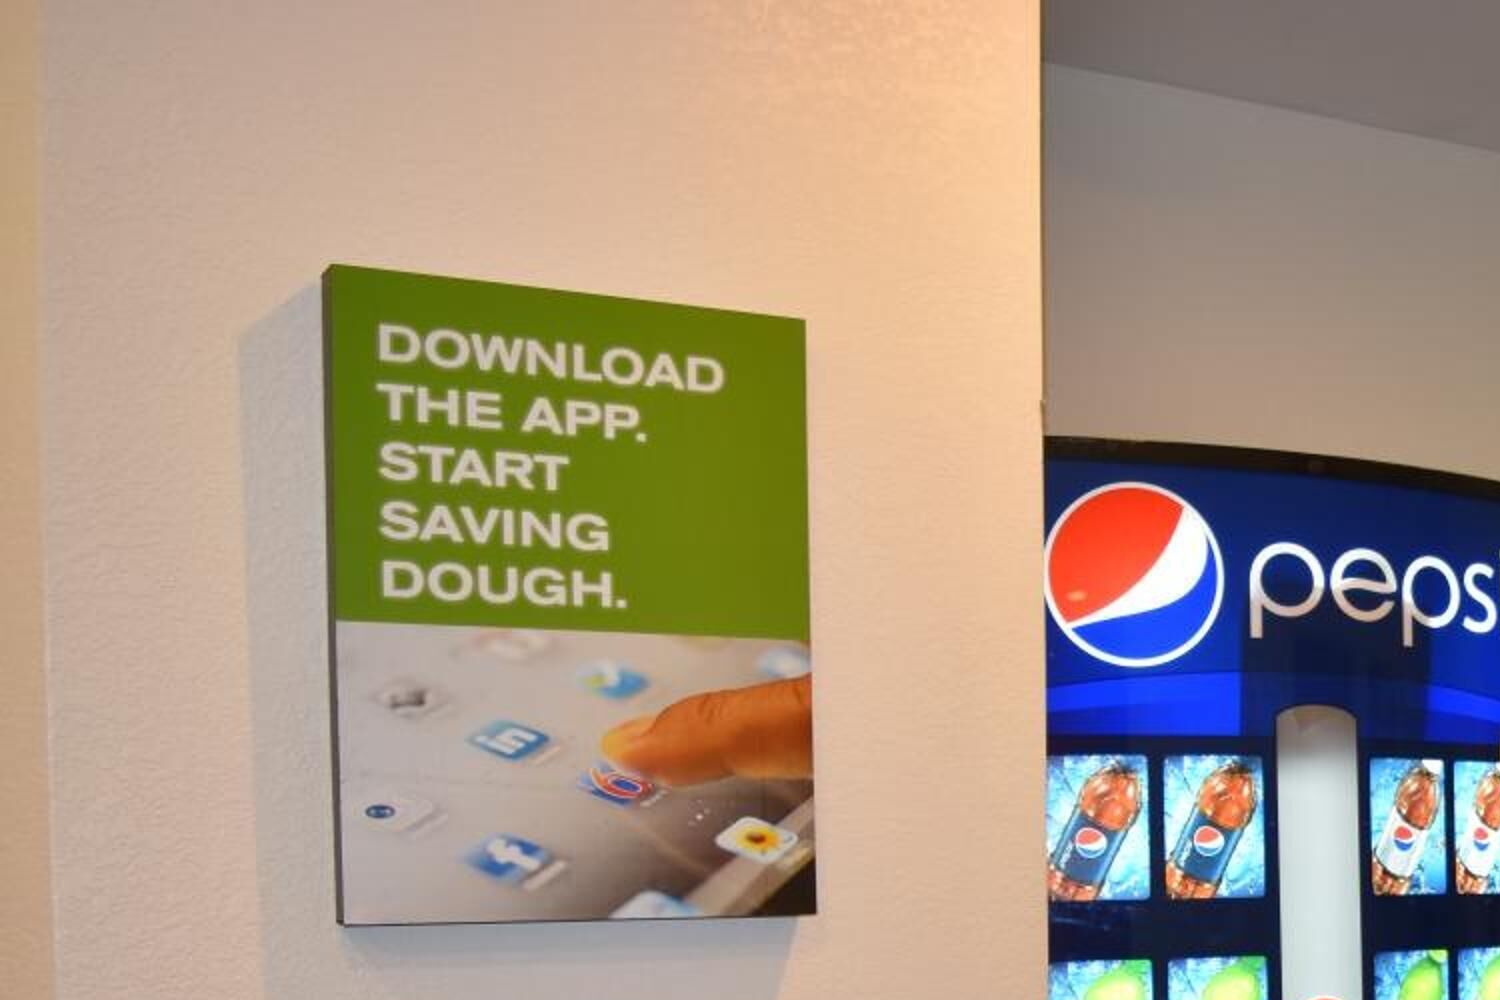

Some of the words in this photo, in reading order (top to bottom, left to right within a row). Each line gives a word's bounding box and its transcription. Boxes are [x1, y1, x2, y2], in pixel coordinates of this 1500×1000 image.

[377, 323, 725, 394] DOWNLOAD
[376, 383, 504, 430] THE
[521, 397, 648, 443] APP.
[379, 442, 569, 492] START
[379, 501, 610, 552] SAVING
[382, 560, 628, 609] DOUGH.
